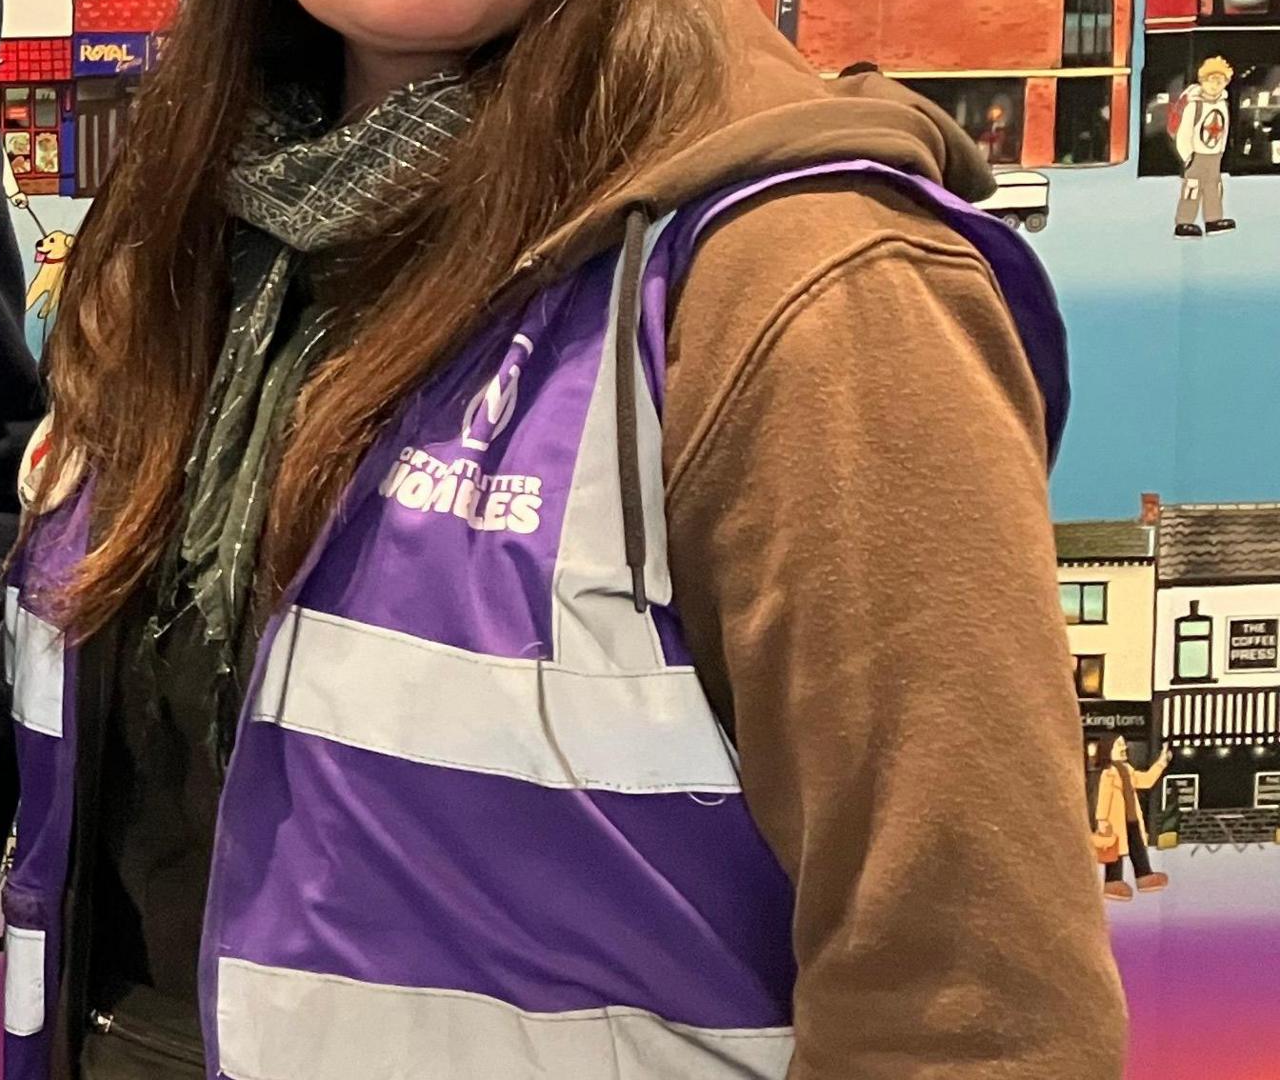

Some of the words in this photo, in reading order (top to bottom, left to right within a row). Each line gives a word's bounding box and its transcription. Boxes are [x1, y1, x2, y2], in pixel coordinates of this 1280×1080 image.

[80, 44, 135, 61] ROYAL
[1243, 623, 1266, 633] THE
[1231, 635, 1276, 647] COFFEE
[1231, 648, 1276, 661] PRESS
